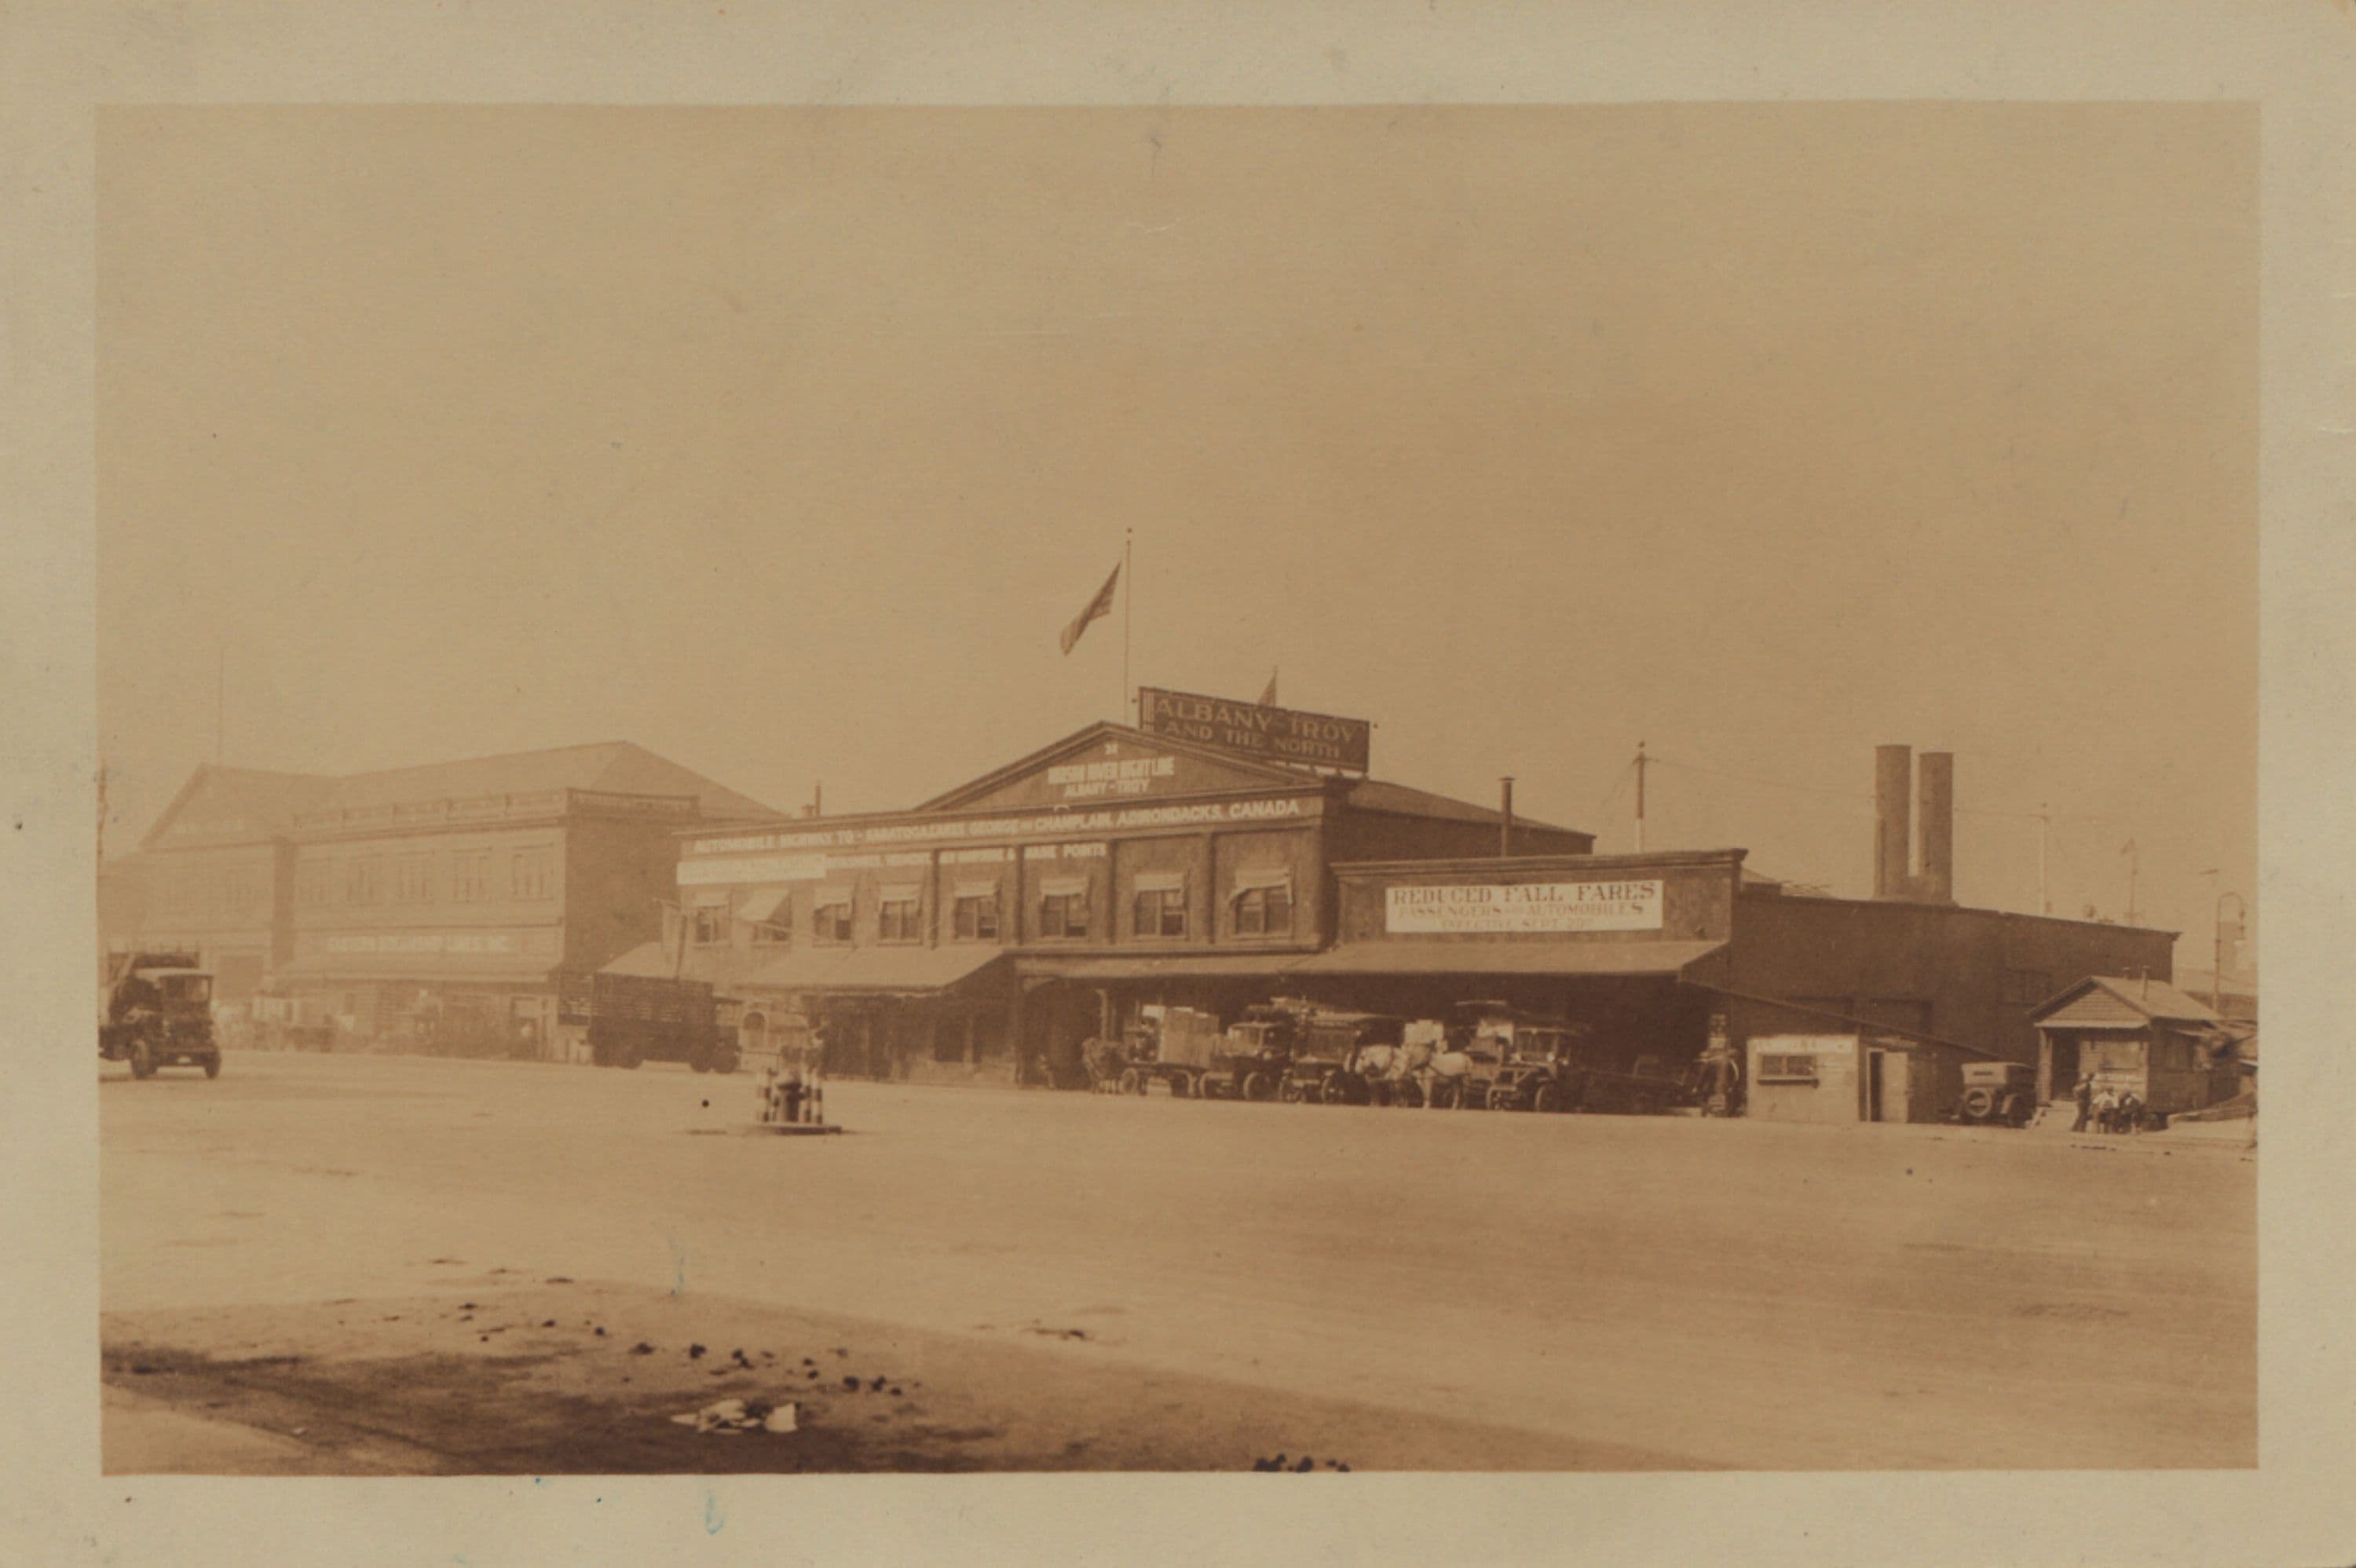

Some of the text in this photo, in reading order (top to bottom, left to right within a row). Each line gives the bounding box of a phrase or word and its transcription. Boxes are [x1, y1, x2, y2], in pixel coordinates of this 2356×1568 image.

[1156, 696, 1273, 733] ALBANY
[1290, 715, 1355, 742] TROY
[1165, 722, 1341, 758] AND THE NORTH
[1229, 799, 1301, 819] CANADA
[1394, 883, 1655, 905] REDUCED FALL FARES
[1399, 905, 1502, 919] PASSENGERS
[1526, 902, 1644, 917] AUTOMOBILES
